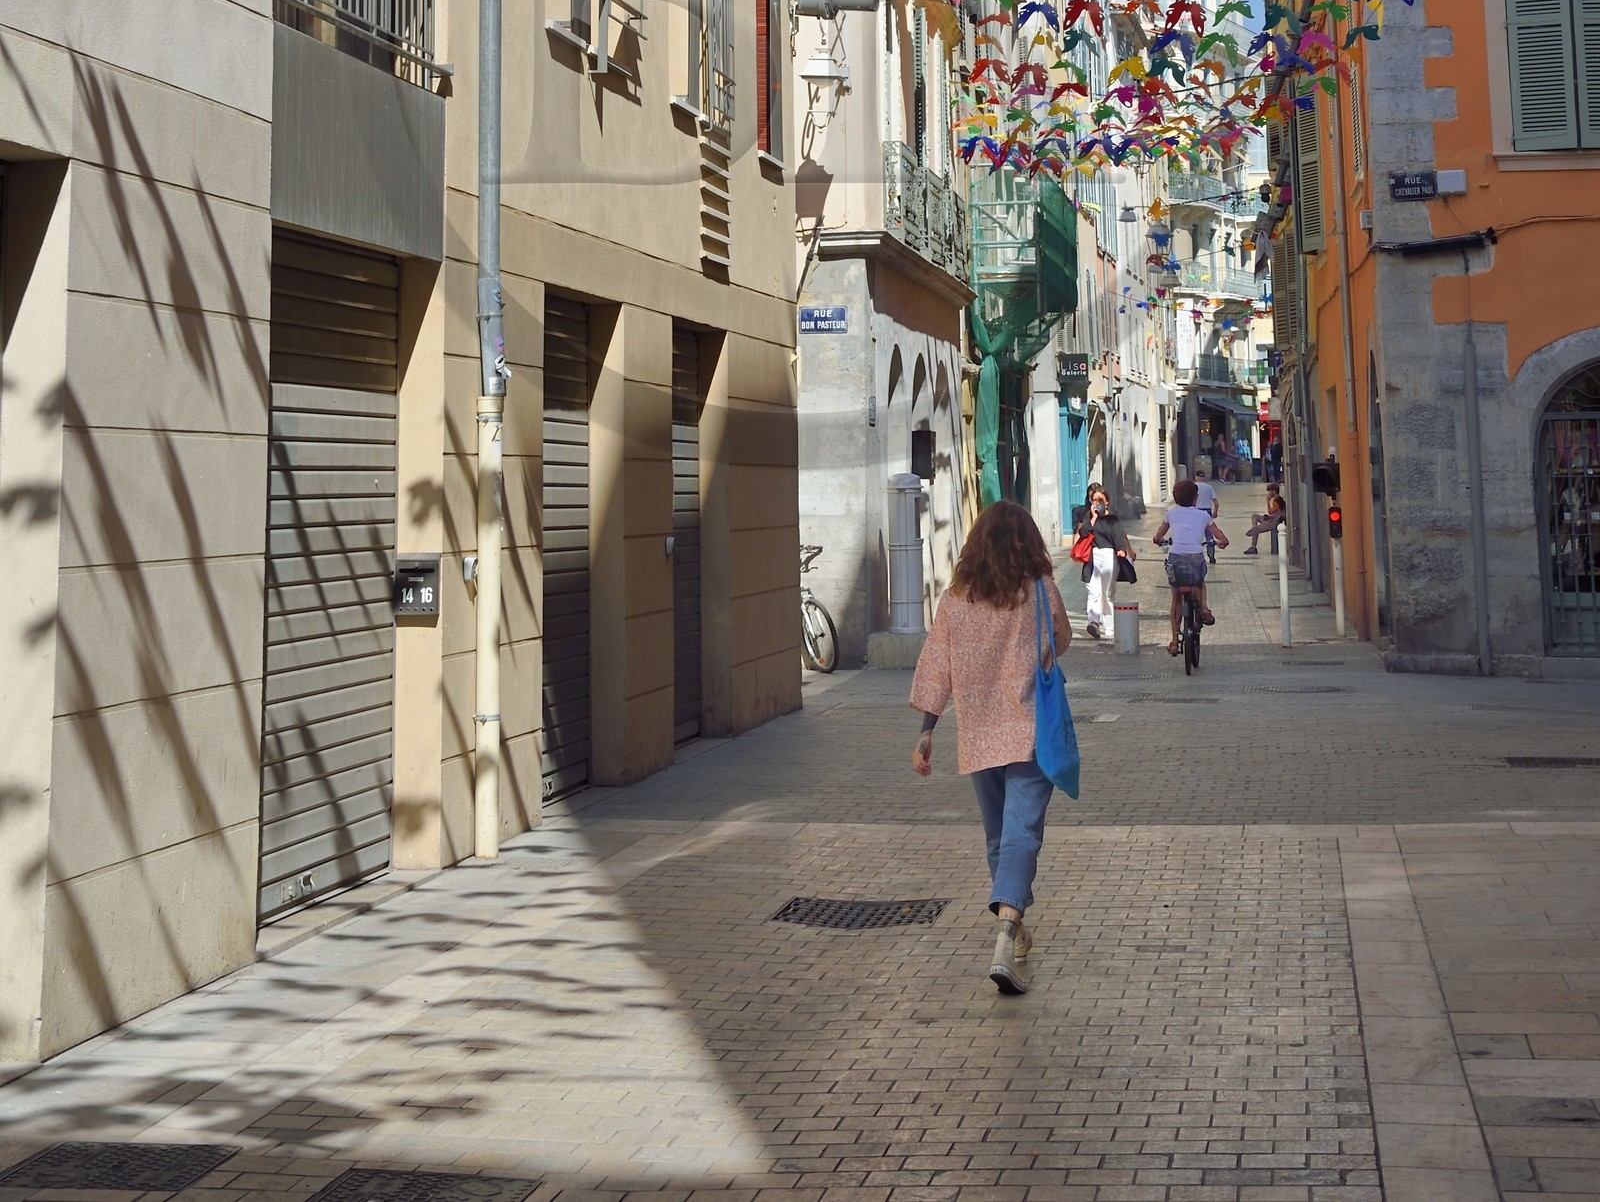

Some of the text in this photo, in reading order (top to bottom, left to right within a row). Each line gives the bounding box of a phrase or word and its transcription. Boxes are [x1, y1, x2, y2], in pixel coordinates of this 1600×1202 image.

[1404, 177, 1421, 185] RUE
[1395, 185, 1434, 196] CHEVALIER PAUL
[813, 309, 833, 318] RUE
[801, 320, 845, 329] BON PASTEUR
[1060, 361, 1087, 370] Lisa
[401, 586, 434, 604] 14 16
